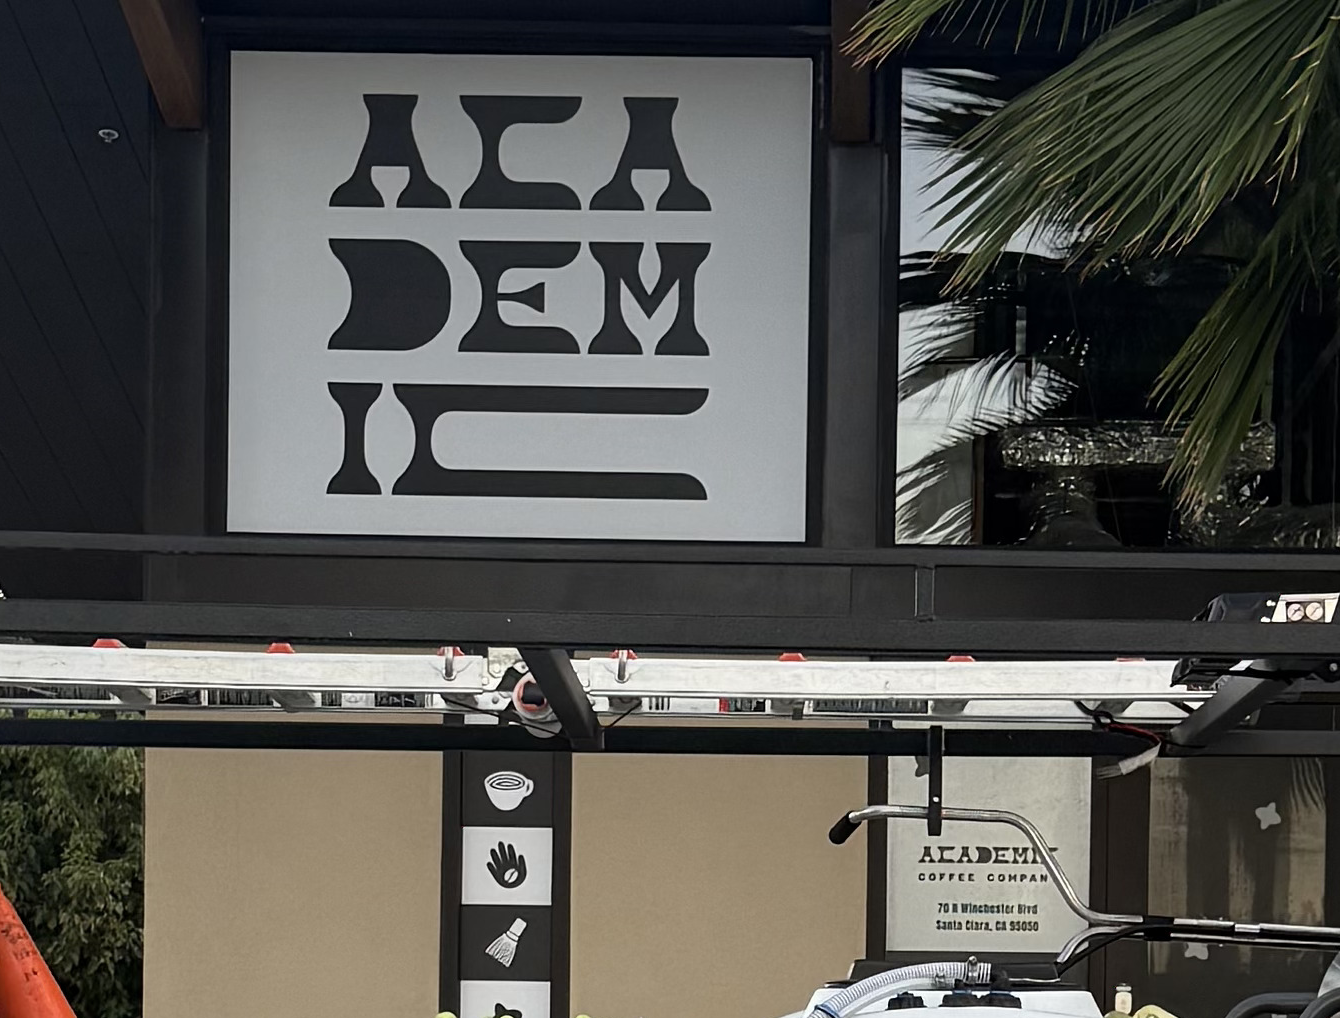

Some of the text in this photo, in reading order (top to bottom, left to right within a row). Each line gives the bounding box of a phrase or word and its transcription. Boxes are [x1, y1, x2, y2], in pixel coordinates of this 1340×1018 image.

[329, 94, 712, 211] ACA
[327, 238, 711, 356] DEM
[918, 873, 1049, 882] COFFEE COMPAN
[938, 903, 950, 914] 70
[1017, 904, 1038, 915] Blvd
[936, 920, 962, 931] Santa
[995, 921, 1007, 931] CA
[1010, 921, 1039, 932] 95050
